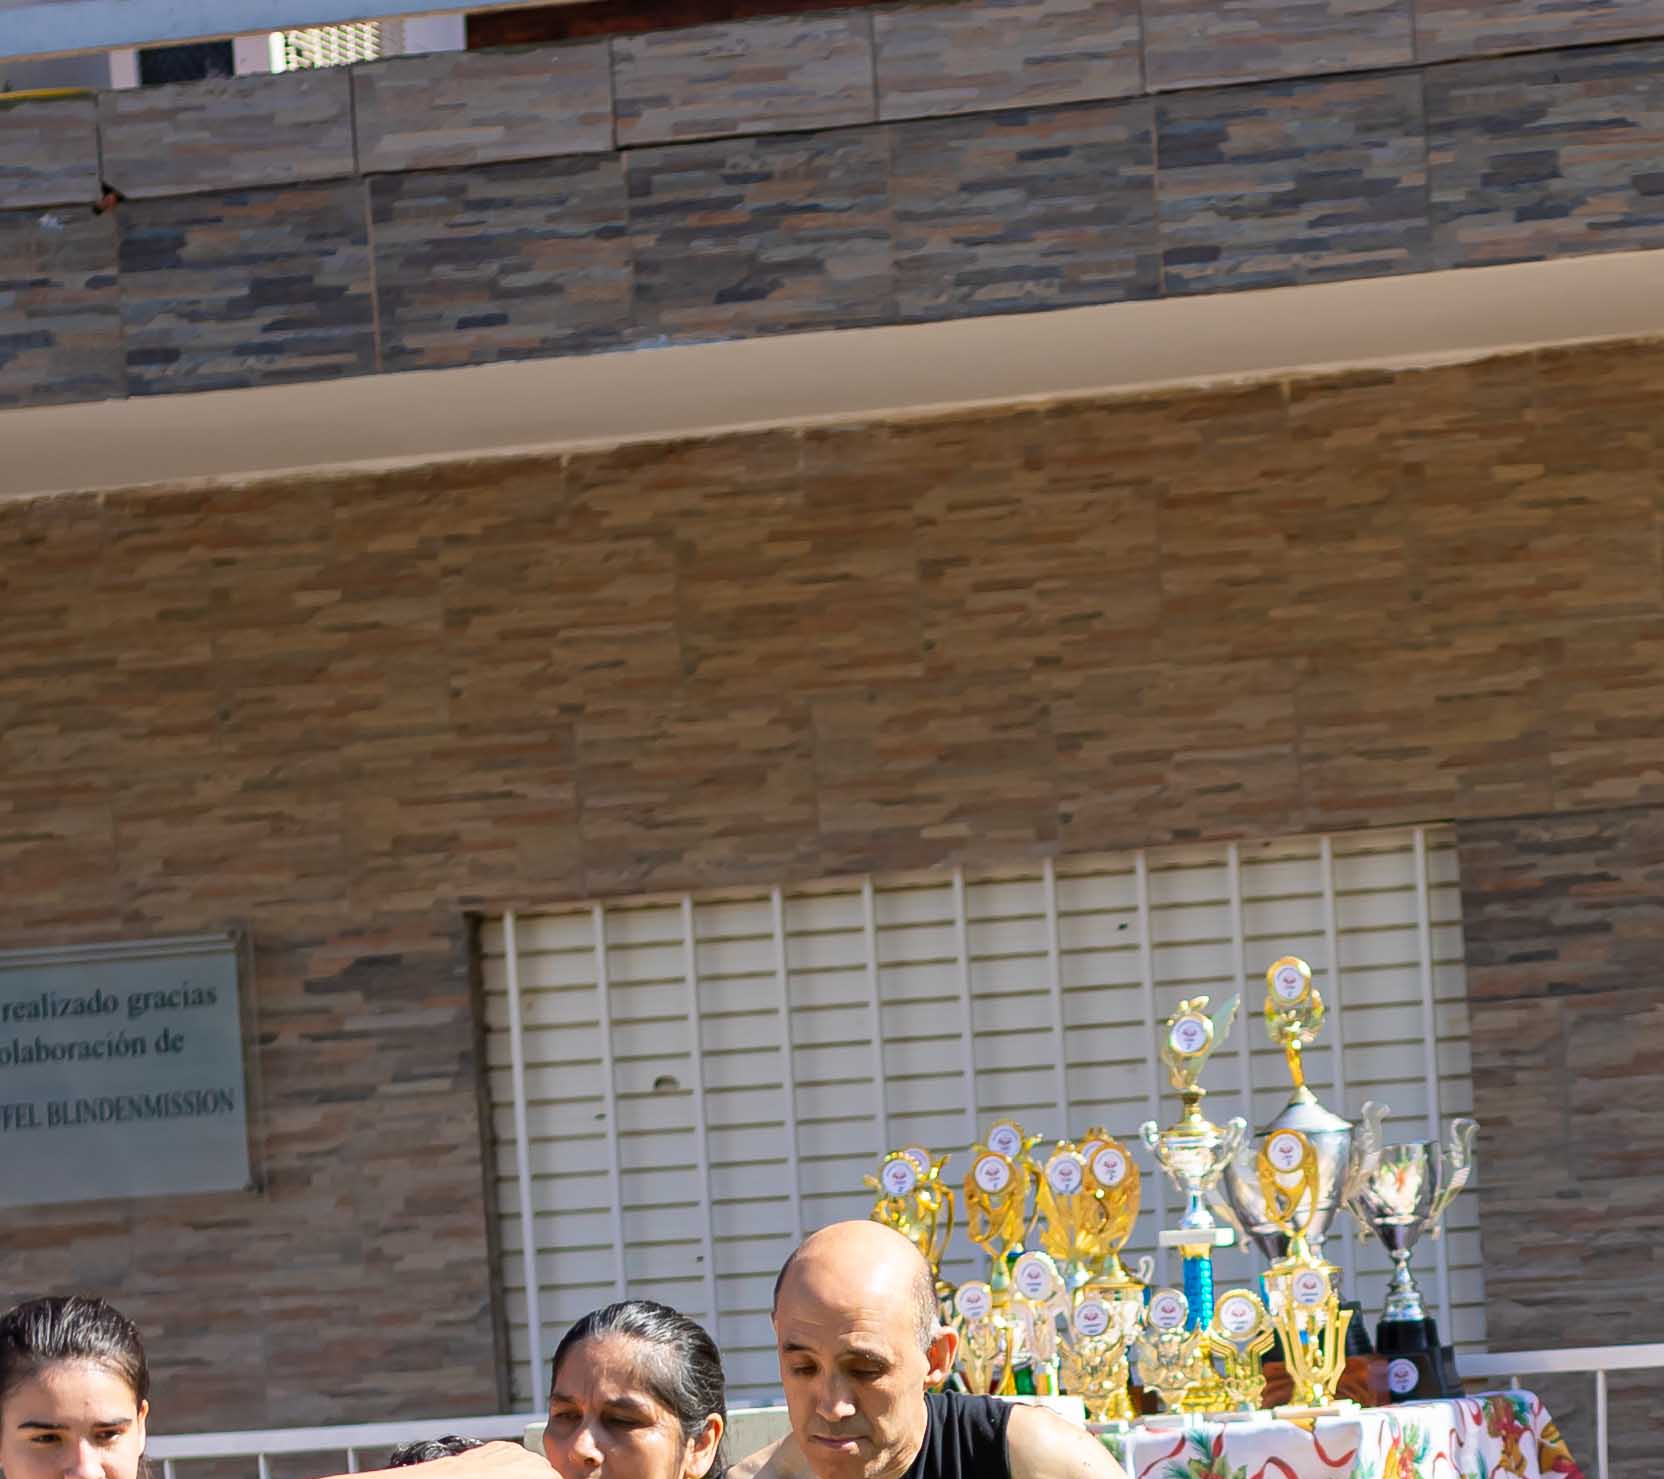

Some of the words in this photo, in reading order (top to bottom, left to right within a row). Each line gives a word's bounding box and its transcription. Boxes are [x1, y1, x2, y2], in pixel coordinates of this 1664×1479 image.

[2, 989, 119, 1024] realizado
[127, 982, 217, 1021] gracias
[155, 1028, 185, 1053] de
[47, 1087, 235, 1130] BLINDENMISSION
